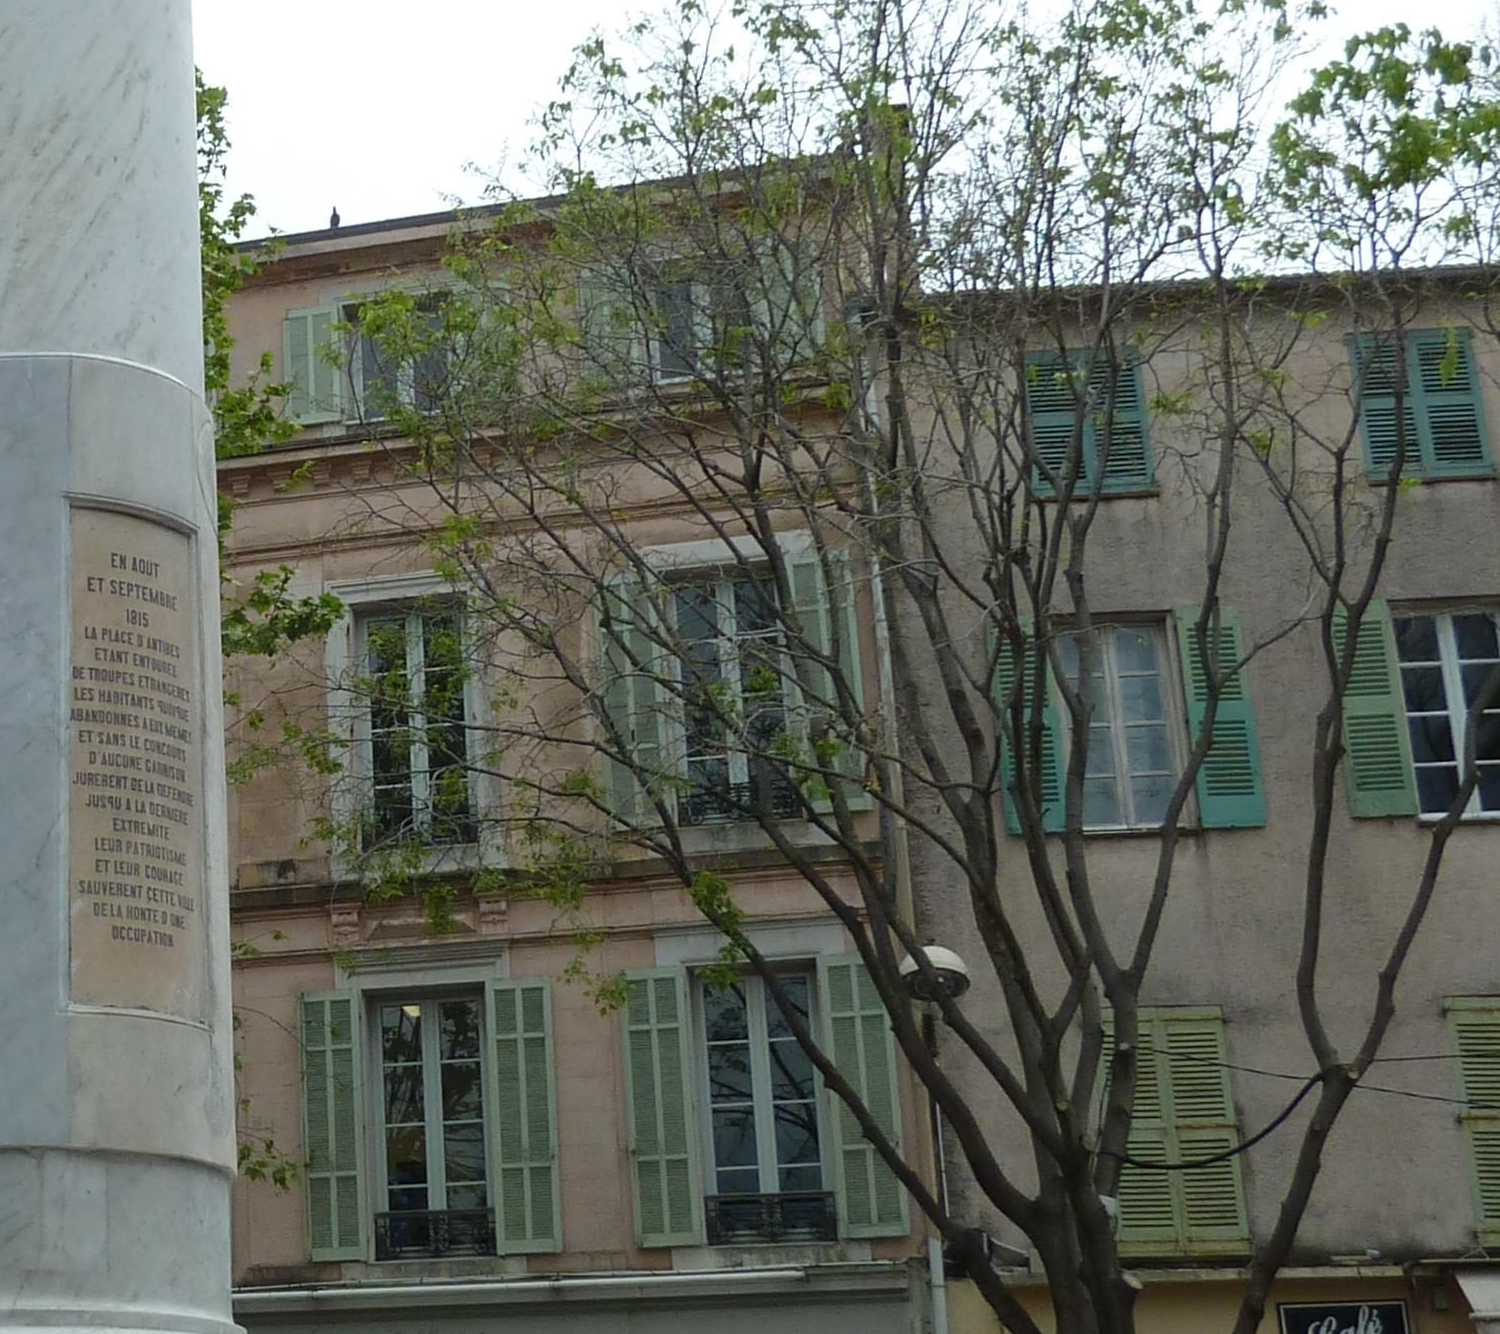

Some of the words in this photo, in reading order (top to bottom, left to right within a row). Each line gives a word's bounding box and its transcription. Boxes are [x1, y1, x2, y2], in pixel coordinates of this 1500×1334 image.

[110, 552, 127, 570] EN
[131, 556, 160, 579] AOUT
[87, 576, 105, 593] ET
[109, 579, 178, 611] SEPTEMBRE
[125, 608, 149, 628] 1815
[84, 626, 97, 640] LA
[101, 627, 134, 645] PLACE
[95, 647, 129, 665] ETANT
[72, 665, 85, 680] DE
[88, 667, 135, 686] TROUPES
[74, 687, 95, 701] LES
[98, 688, 155, 710] HABITANTS
[69, 708, 140, 729] ABANDONNES
[78, 730, 93, 743] ET
[98, 731, 126, 747] SANS
[130, 735, 141, 749] LE
[144, 738, 186, 763] CONCOURS
[72, 771, 128, 790] JURERENT
[135, 799, 146, 814] LA
[149, 801, 189, 826] DERNIERE
[112, 817, 171, 841] EXTREMITE
[94, 837, 123, 853] LEUR
[125, 842, 187, 867] PATRIOTISME
[94, 858, 109, 874] ET
[114, 860, 141, 877] LEUR
[144, 864, 184, 887] COURAGE
[78, 880, 142, 899] SAUVERENT
[146, 886, 176, 906] CETTE
[177, 893, 195, 912] VILLE
[93, 902, 109, 917] DE
[110, 903, 123, 919] LA
[126, 905, 159, 924] HONTE
[112, 925, 174, 948] OCCUPATION
